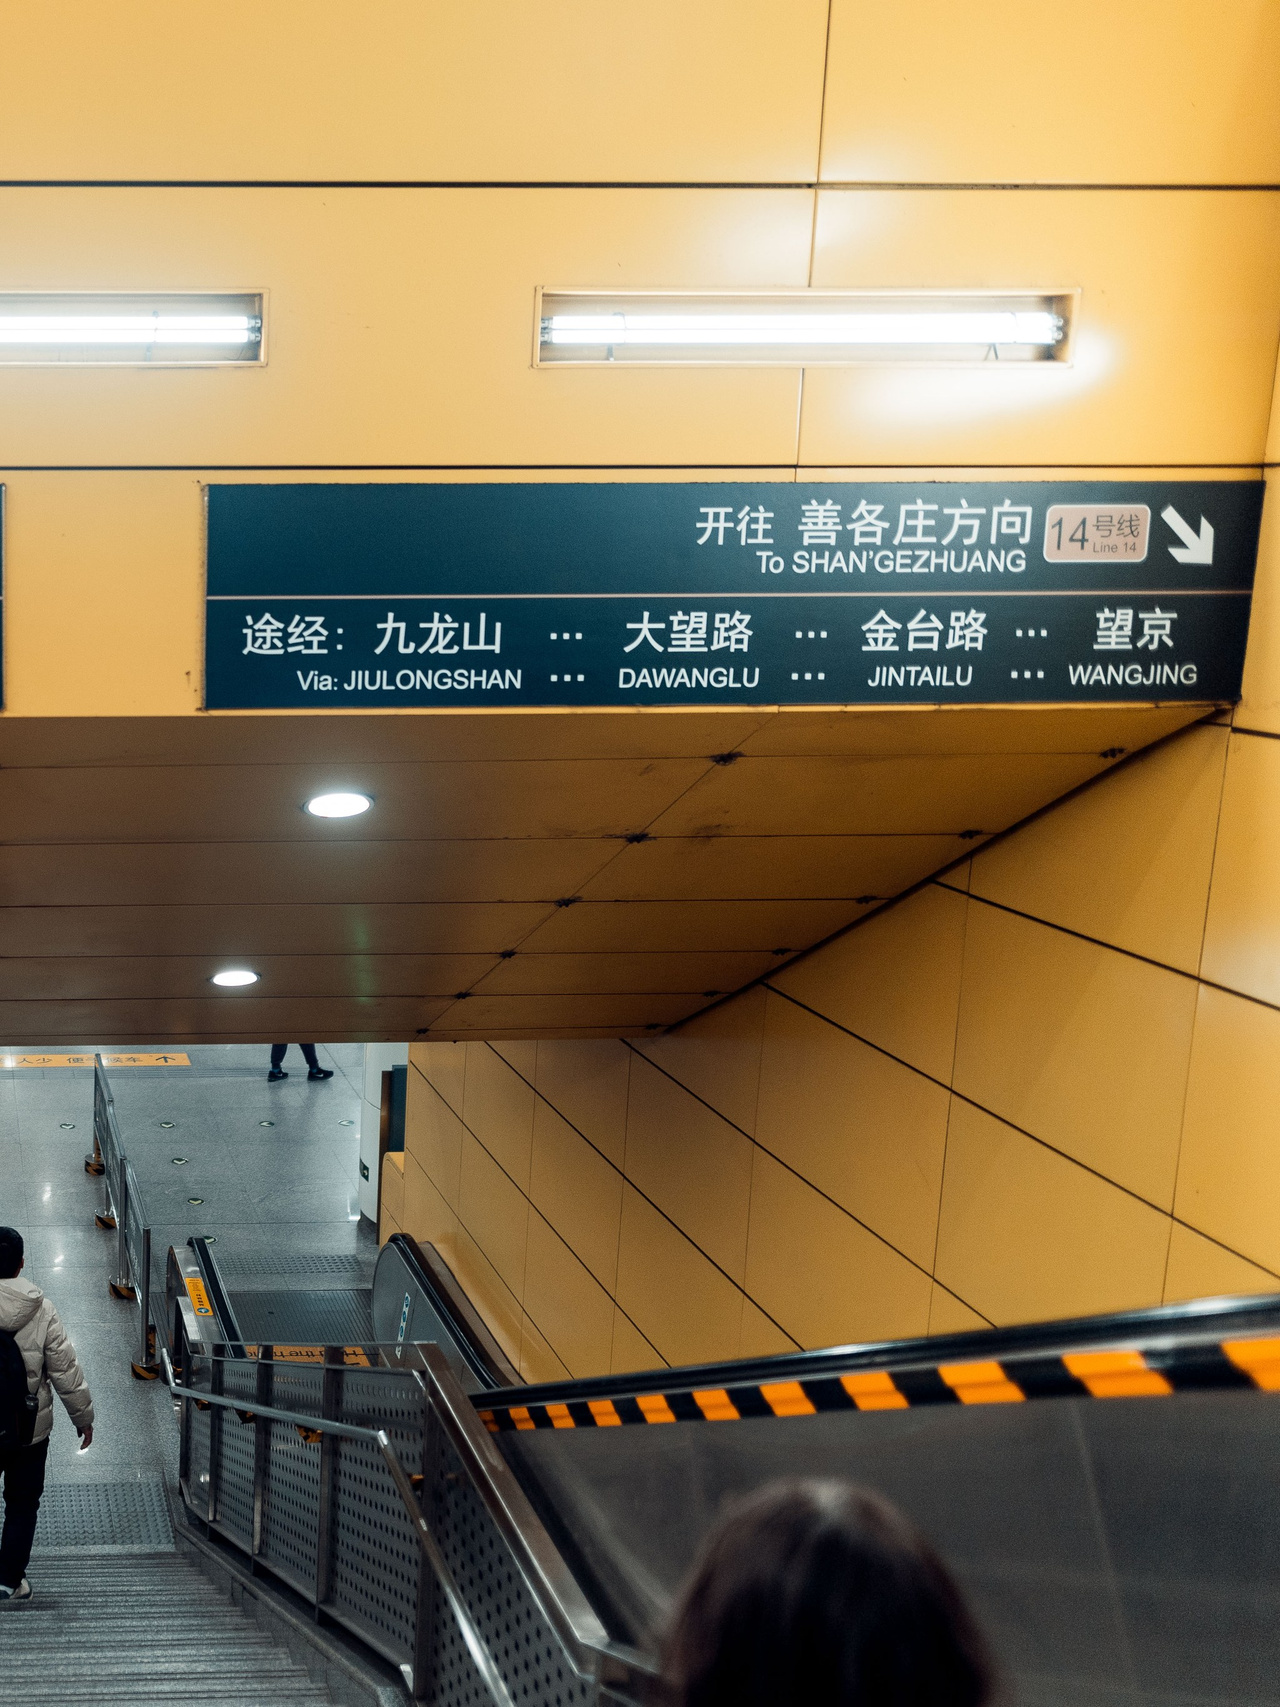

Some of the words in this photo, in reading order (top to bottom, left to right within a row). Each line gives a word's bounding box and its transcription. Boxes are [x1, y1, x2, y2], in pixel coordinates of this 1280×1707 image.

[695, 505, 775, 546] 开往
[798, 497, 1033, 546] 善各庄方向
[1092, 542, 1119, 554] Line
[1124, 541, 1137, 553] 14
[755, 550, 785, 574] To
[374, 611, 502, 655] 九龙山
[623, 610, 754, 653] 大望路
[861, 608, 988, 652] 金台路
[1092, 607, 1178, 651] 望京
[296, 670, 338, 691] Via:
[343, 668, 522, 691] JIULONGSHAN
[618, 667, 760, 689] DAWANGLU
[867, 665, 973, 687] JINTAILU
[1068, 664, 1197, 686] WANGJING
